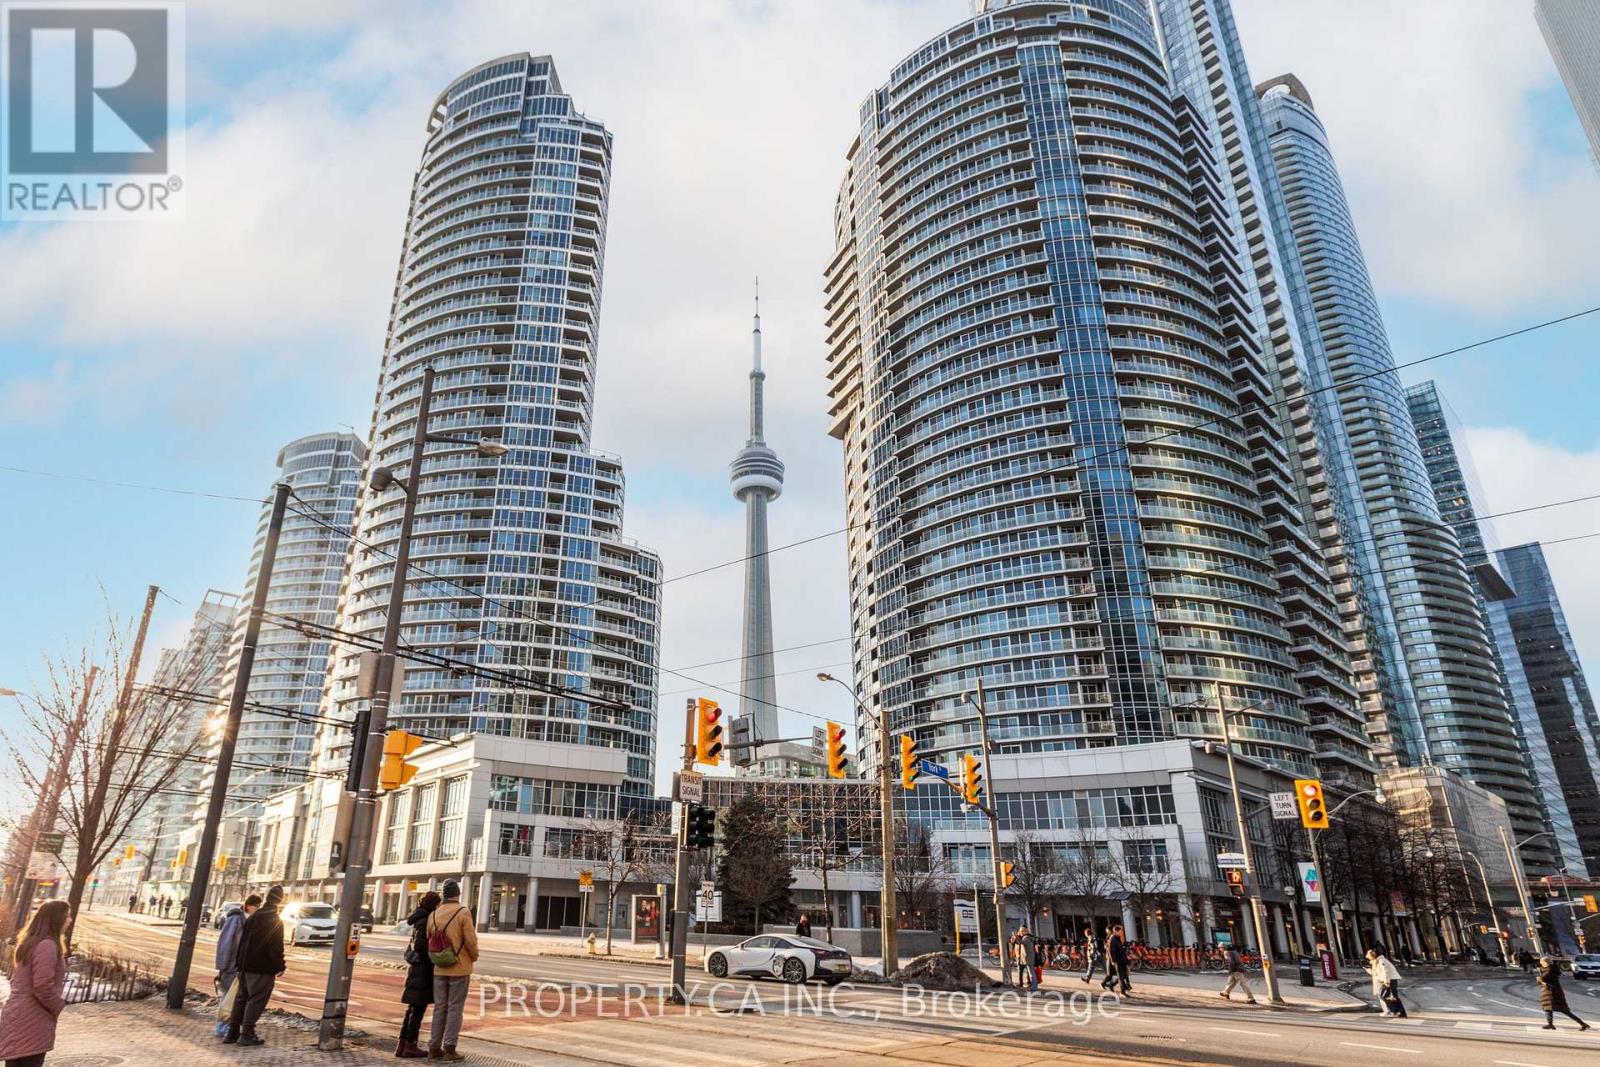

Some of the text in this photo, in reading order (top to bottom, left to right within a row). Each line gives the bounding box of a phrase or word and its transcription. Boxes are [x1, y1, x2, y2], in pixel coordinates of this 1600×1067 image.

[928, 764, 938, 773] York
[681, 773, 703, 785] TRANSIT
[682, 785, 700, 797] SIGNAL
[702, 890, 714, 900] 40
